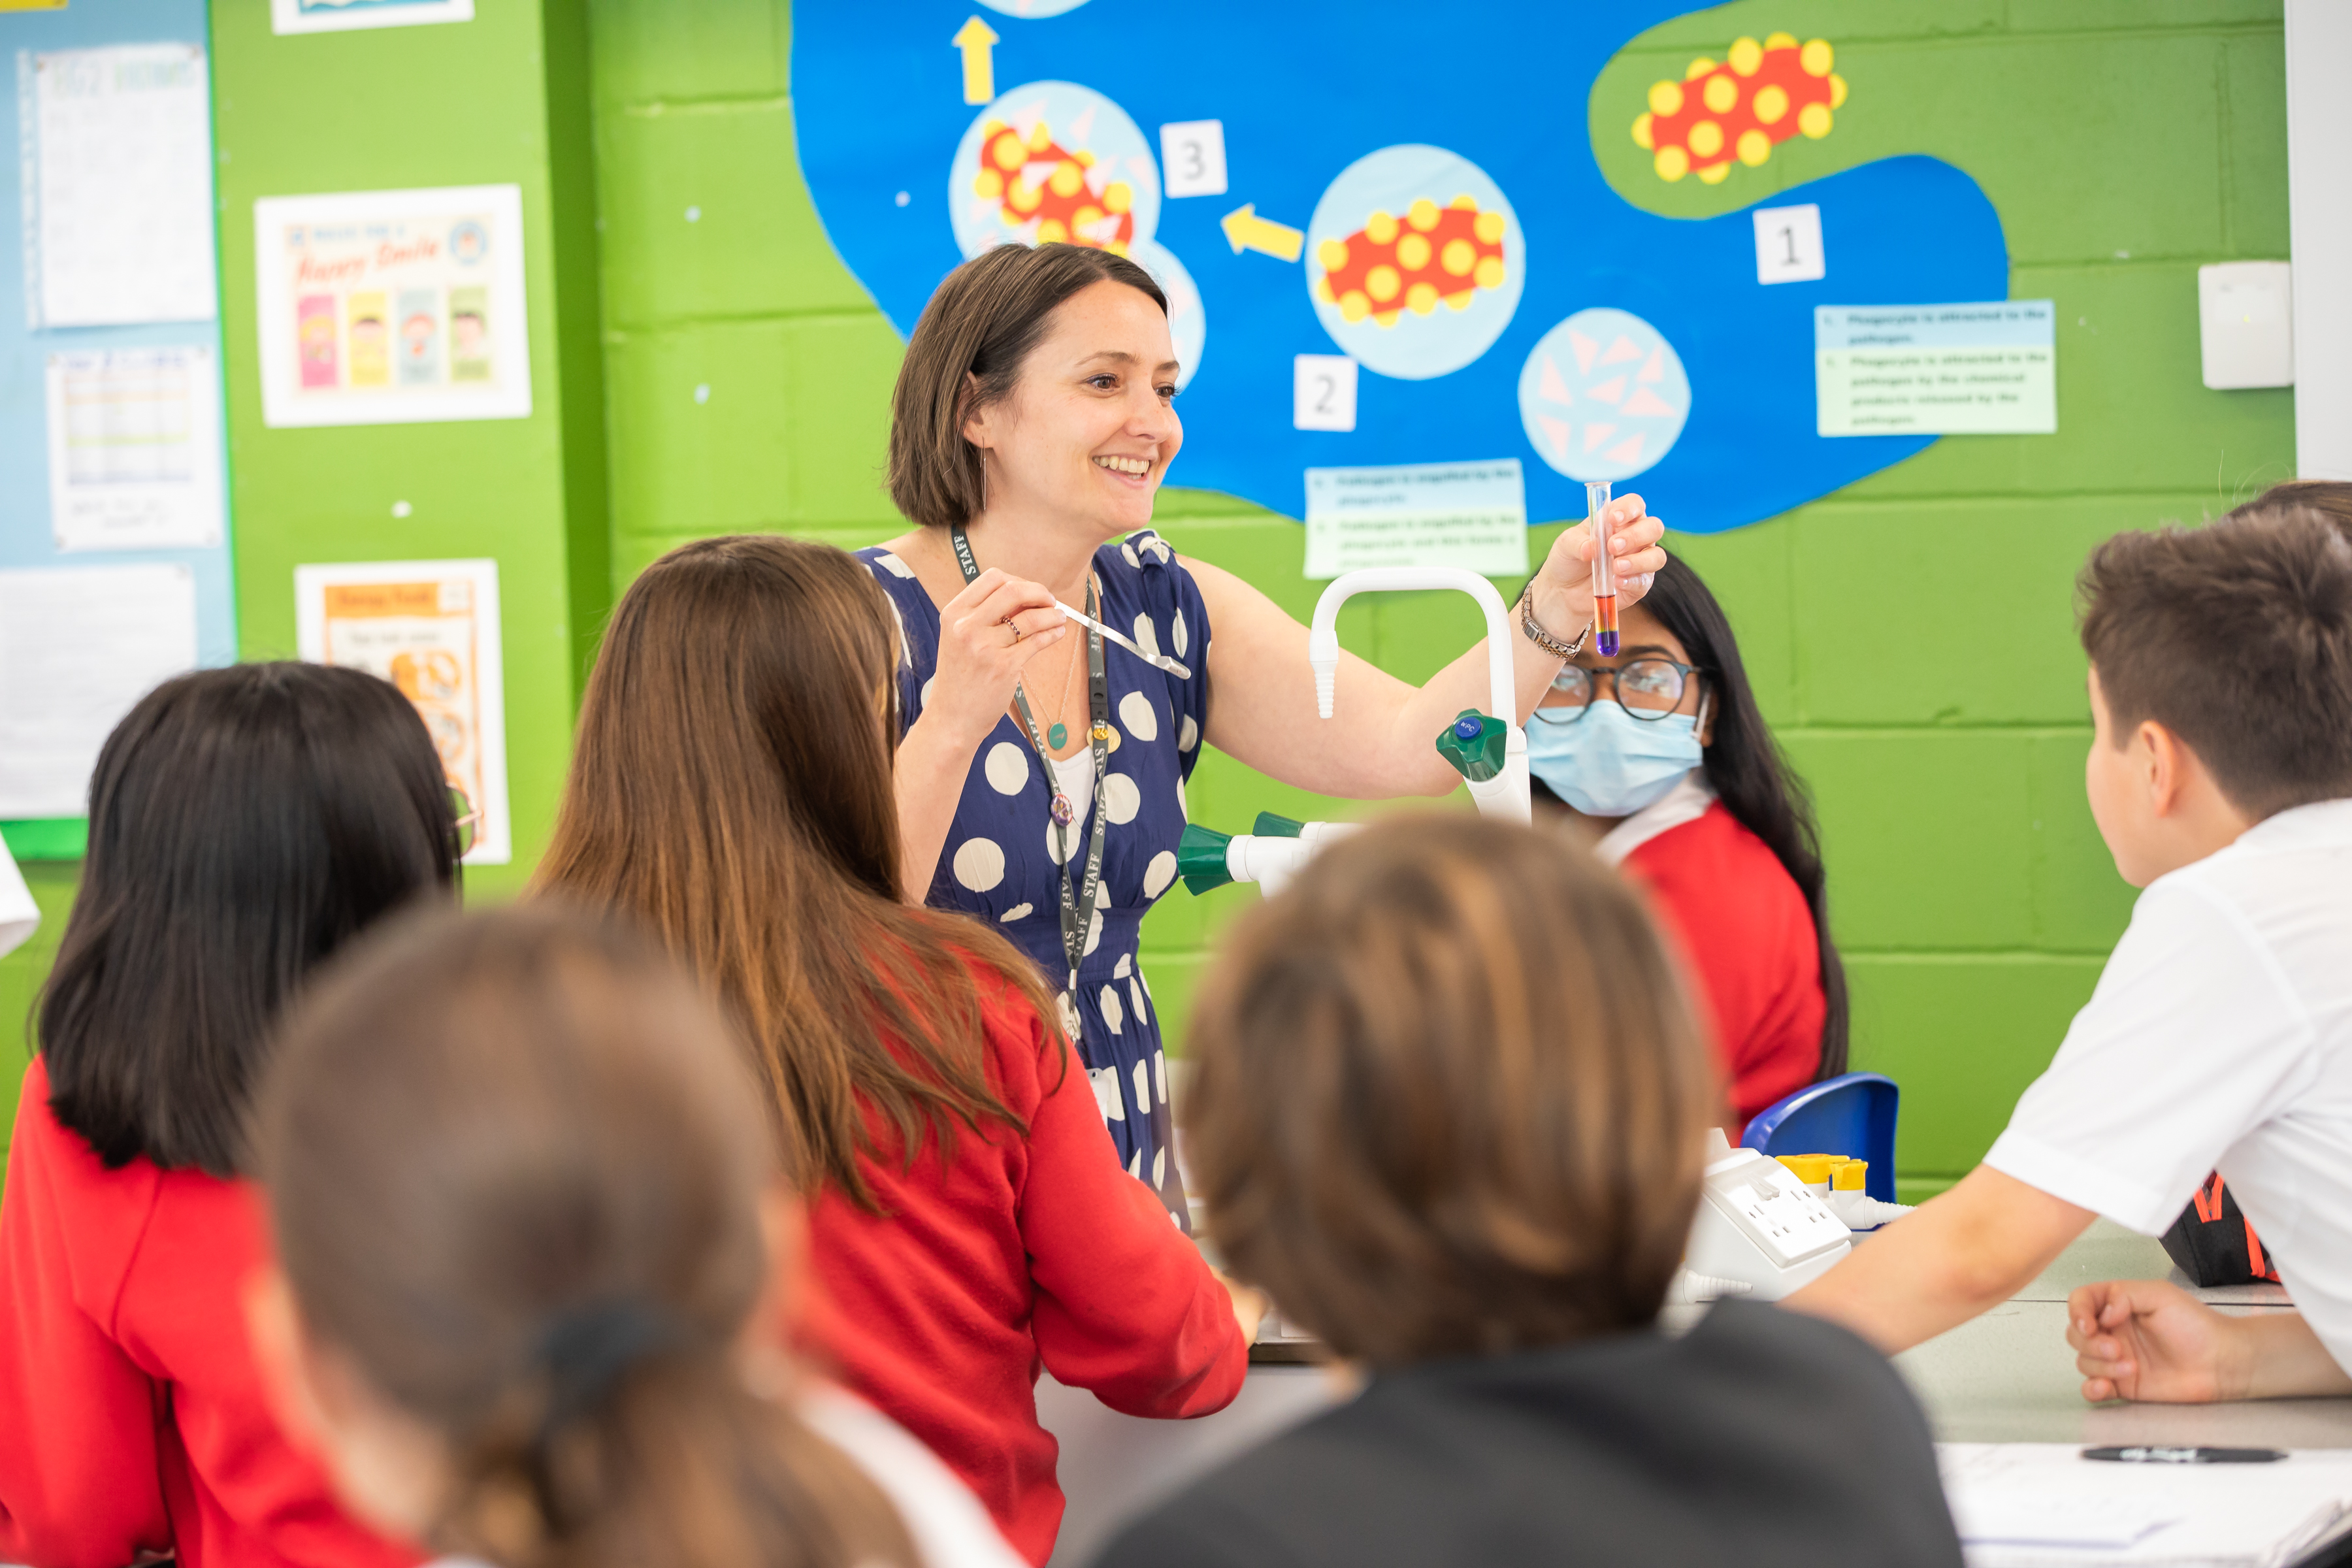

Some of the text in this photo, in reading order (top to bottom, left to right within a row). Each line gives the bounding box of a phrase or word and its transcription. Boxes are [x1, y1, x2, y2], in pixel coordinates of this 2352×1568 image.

[1181, 139, 1205, 180] 3
[1777, 226, 1801, 267] 1
[1315, 374, 1335, 414] 2
[954, 535, 977, 575] STAFF
[1090, 610, 1101, 653] SFF
[1461, 721, 1475, 732] WPC
[1062, 874, 1073, 910] TAFF
[1083, 853, 1100, 898] STAFF
